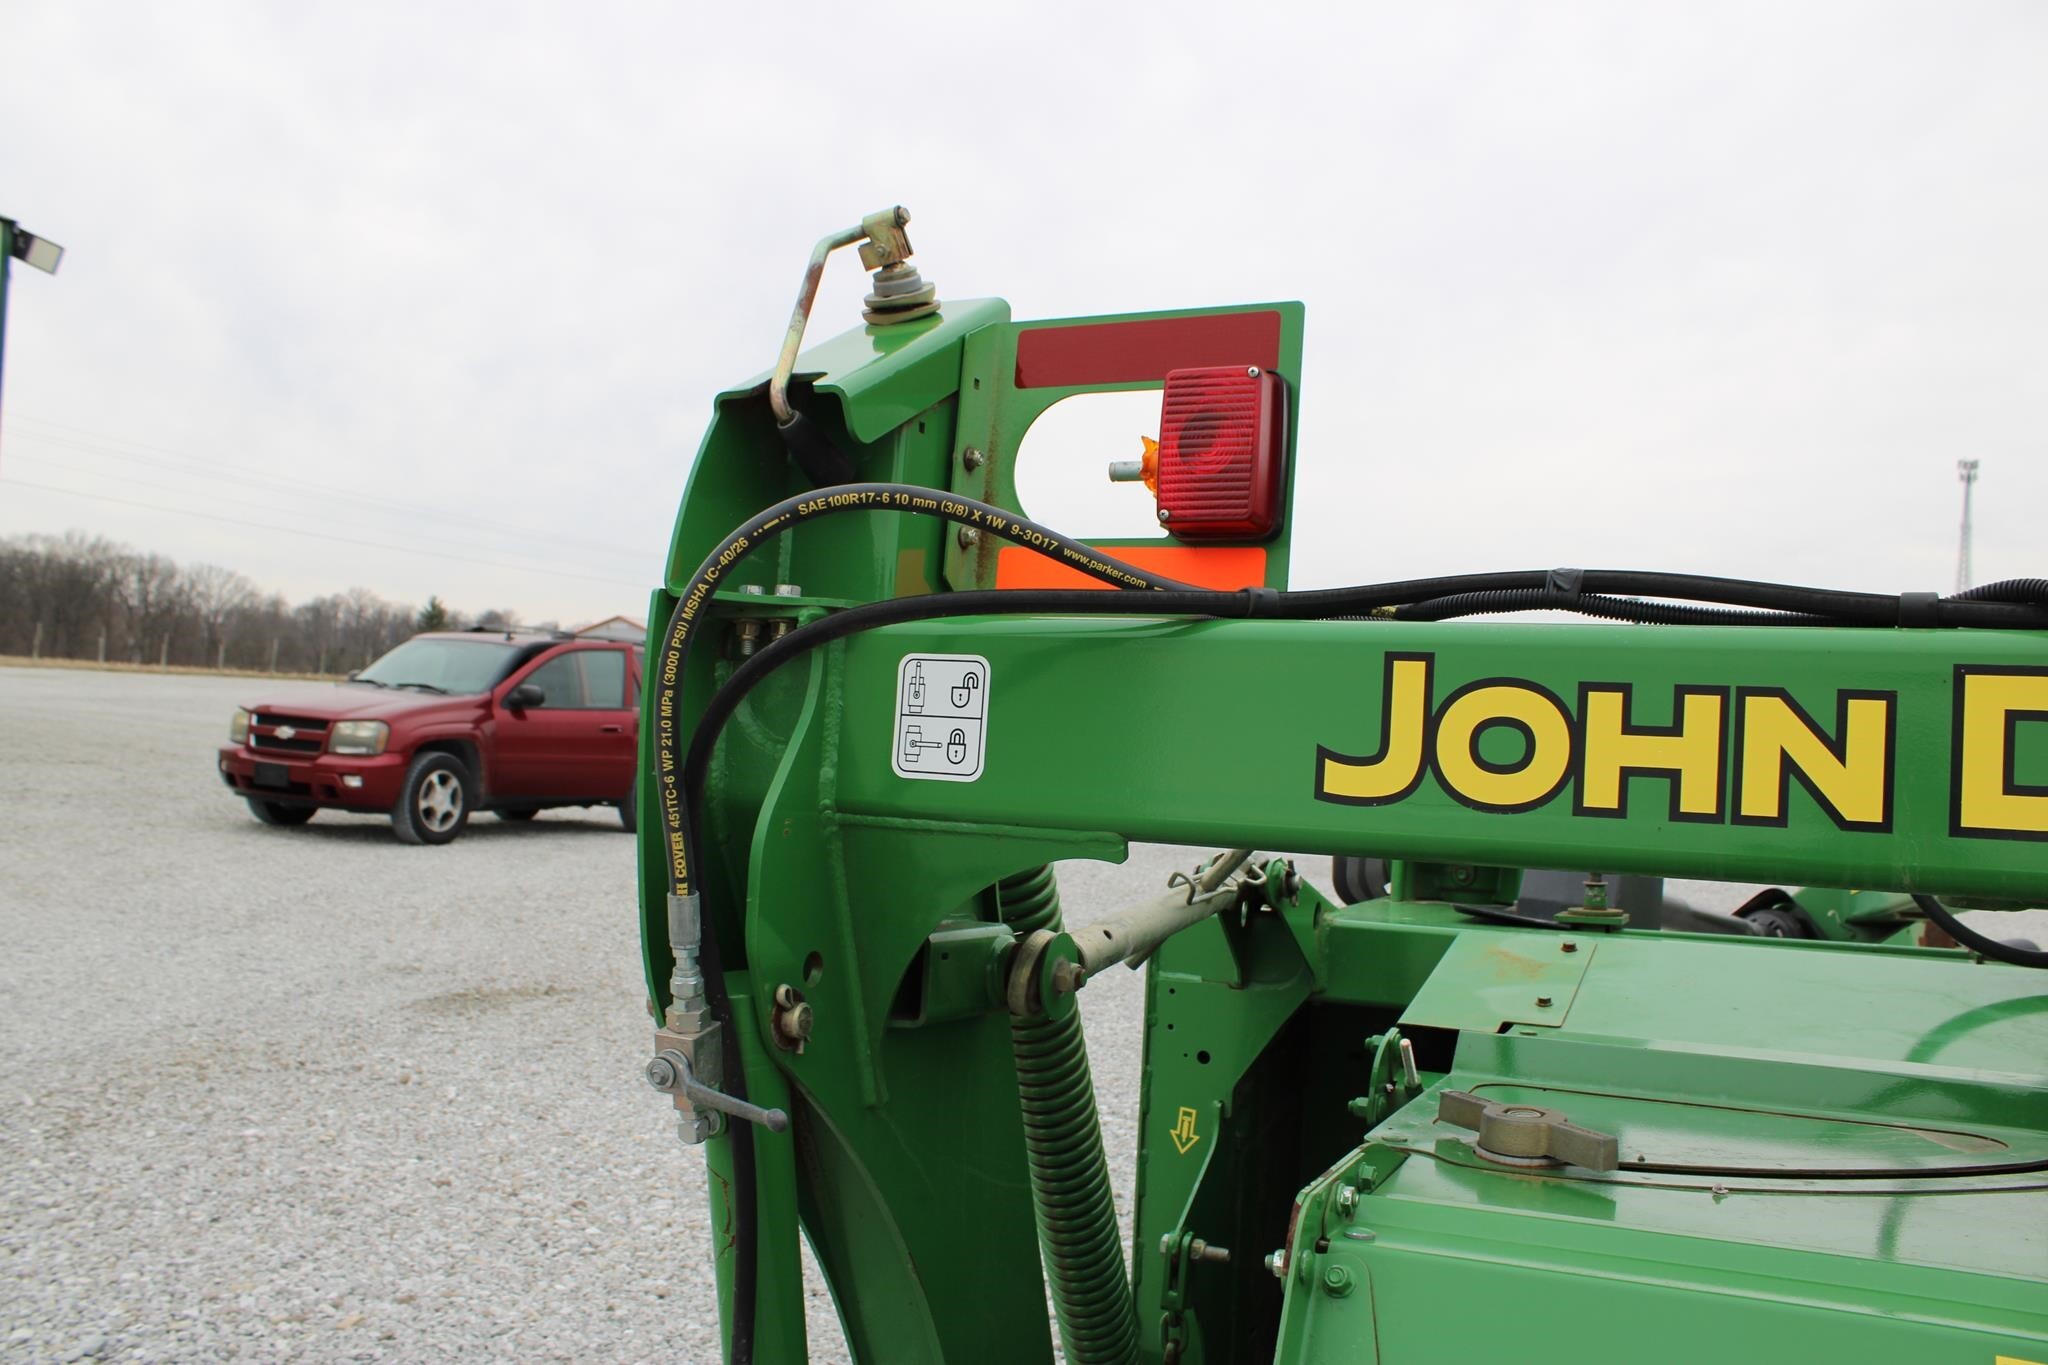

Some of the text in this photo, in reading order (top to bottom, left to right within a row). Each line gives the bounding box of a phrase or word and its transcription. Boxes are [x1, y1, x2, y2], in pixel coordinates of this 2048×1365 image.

[894, 493, 909, 505] 10
[912, 496, 937, 509] mm
[941, 500, 969, 518] (3/8)
[972, 510, 982, 522] X
[985, 514, 1006, 530] 1W
[1010, 524, 1059, 551] 9-3Q17
[704, 537, 749, 583] IC-40/26
[1063, 546, 1147, 589] www.parker.com
[681, 582, 710, 620] MSHA
[671, 621, 690, 648] PSI)
[662, 650, 680, 686] (3000
[661, 689, 673, 717] MPa
[1313, 651, 1898, 834] JOHN
[661, 750, 674, 772] WP
[664, 775, 681, 828] 451TC-6
[670, 832, 688, 879] COVER
